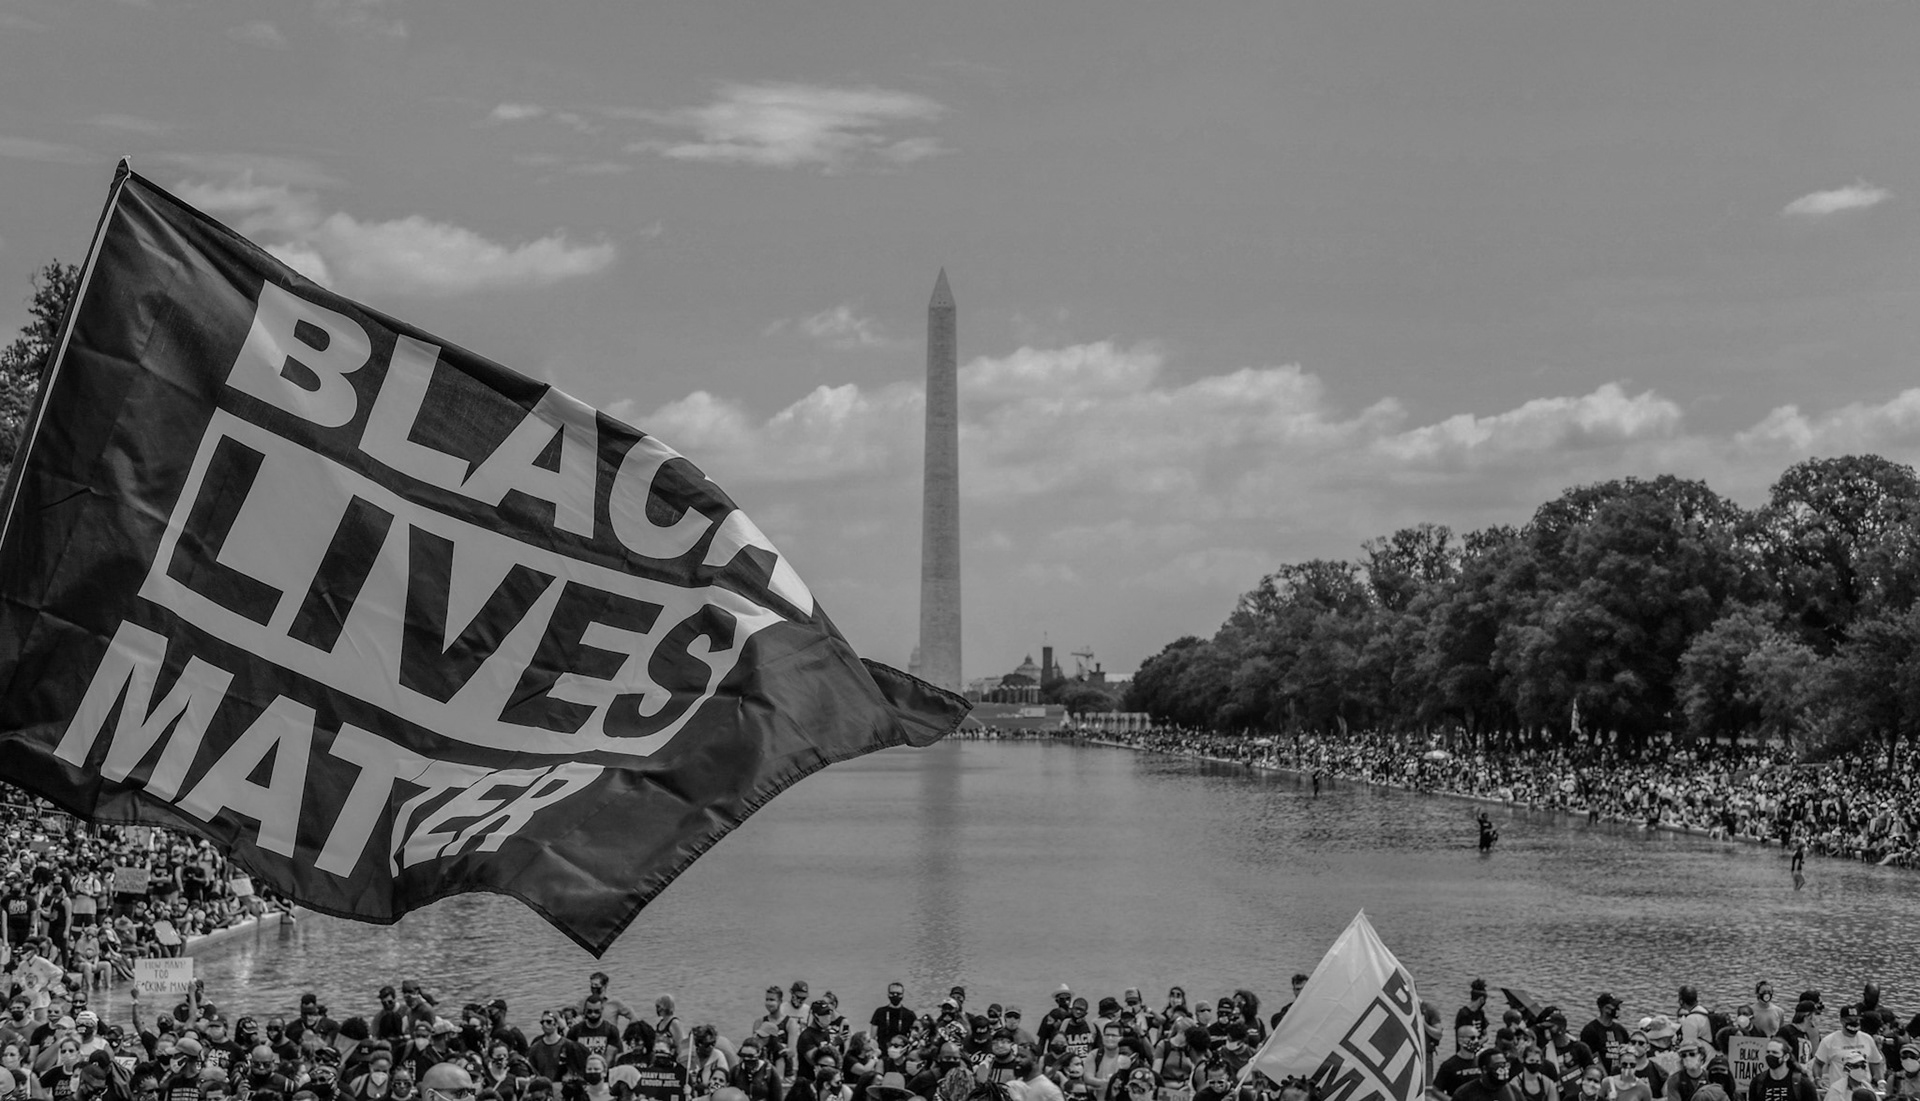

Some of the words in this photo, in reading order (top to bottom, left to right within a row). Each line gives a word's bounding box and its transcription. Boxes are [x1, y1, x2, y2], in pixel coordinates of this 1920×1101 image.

[225, 279, 814, 618] BLACK
[166, 434, 738, 738] LIVES
[53, 620, 605, 879] MATTER
[1066, 1033, 1094, 1045] LACK
[1740, 1048, 1759, 1060] BLACK
